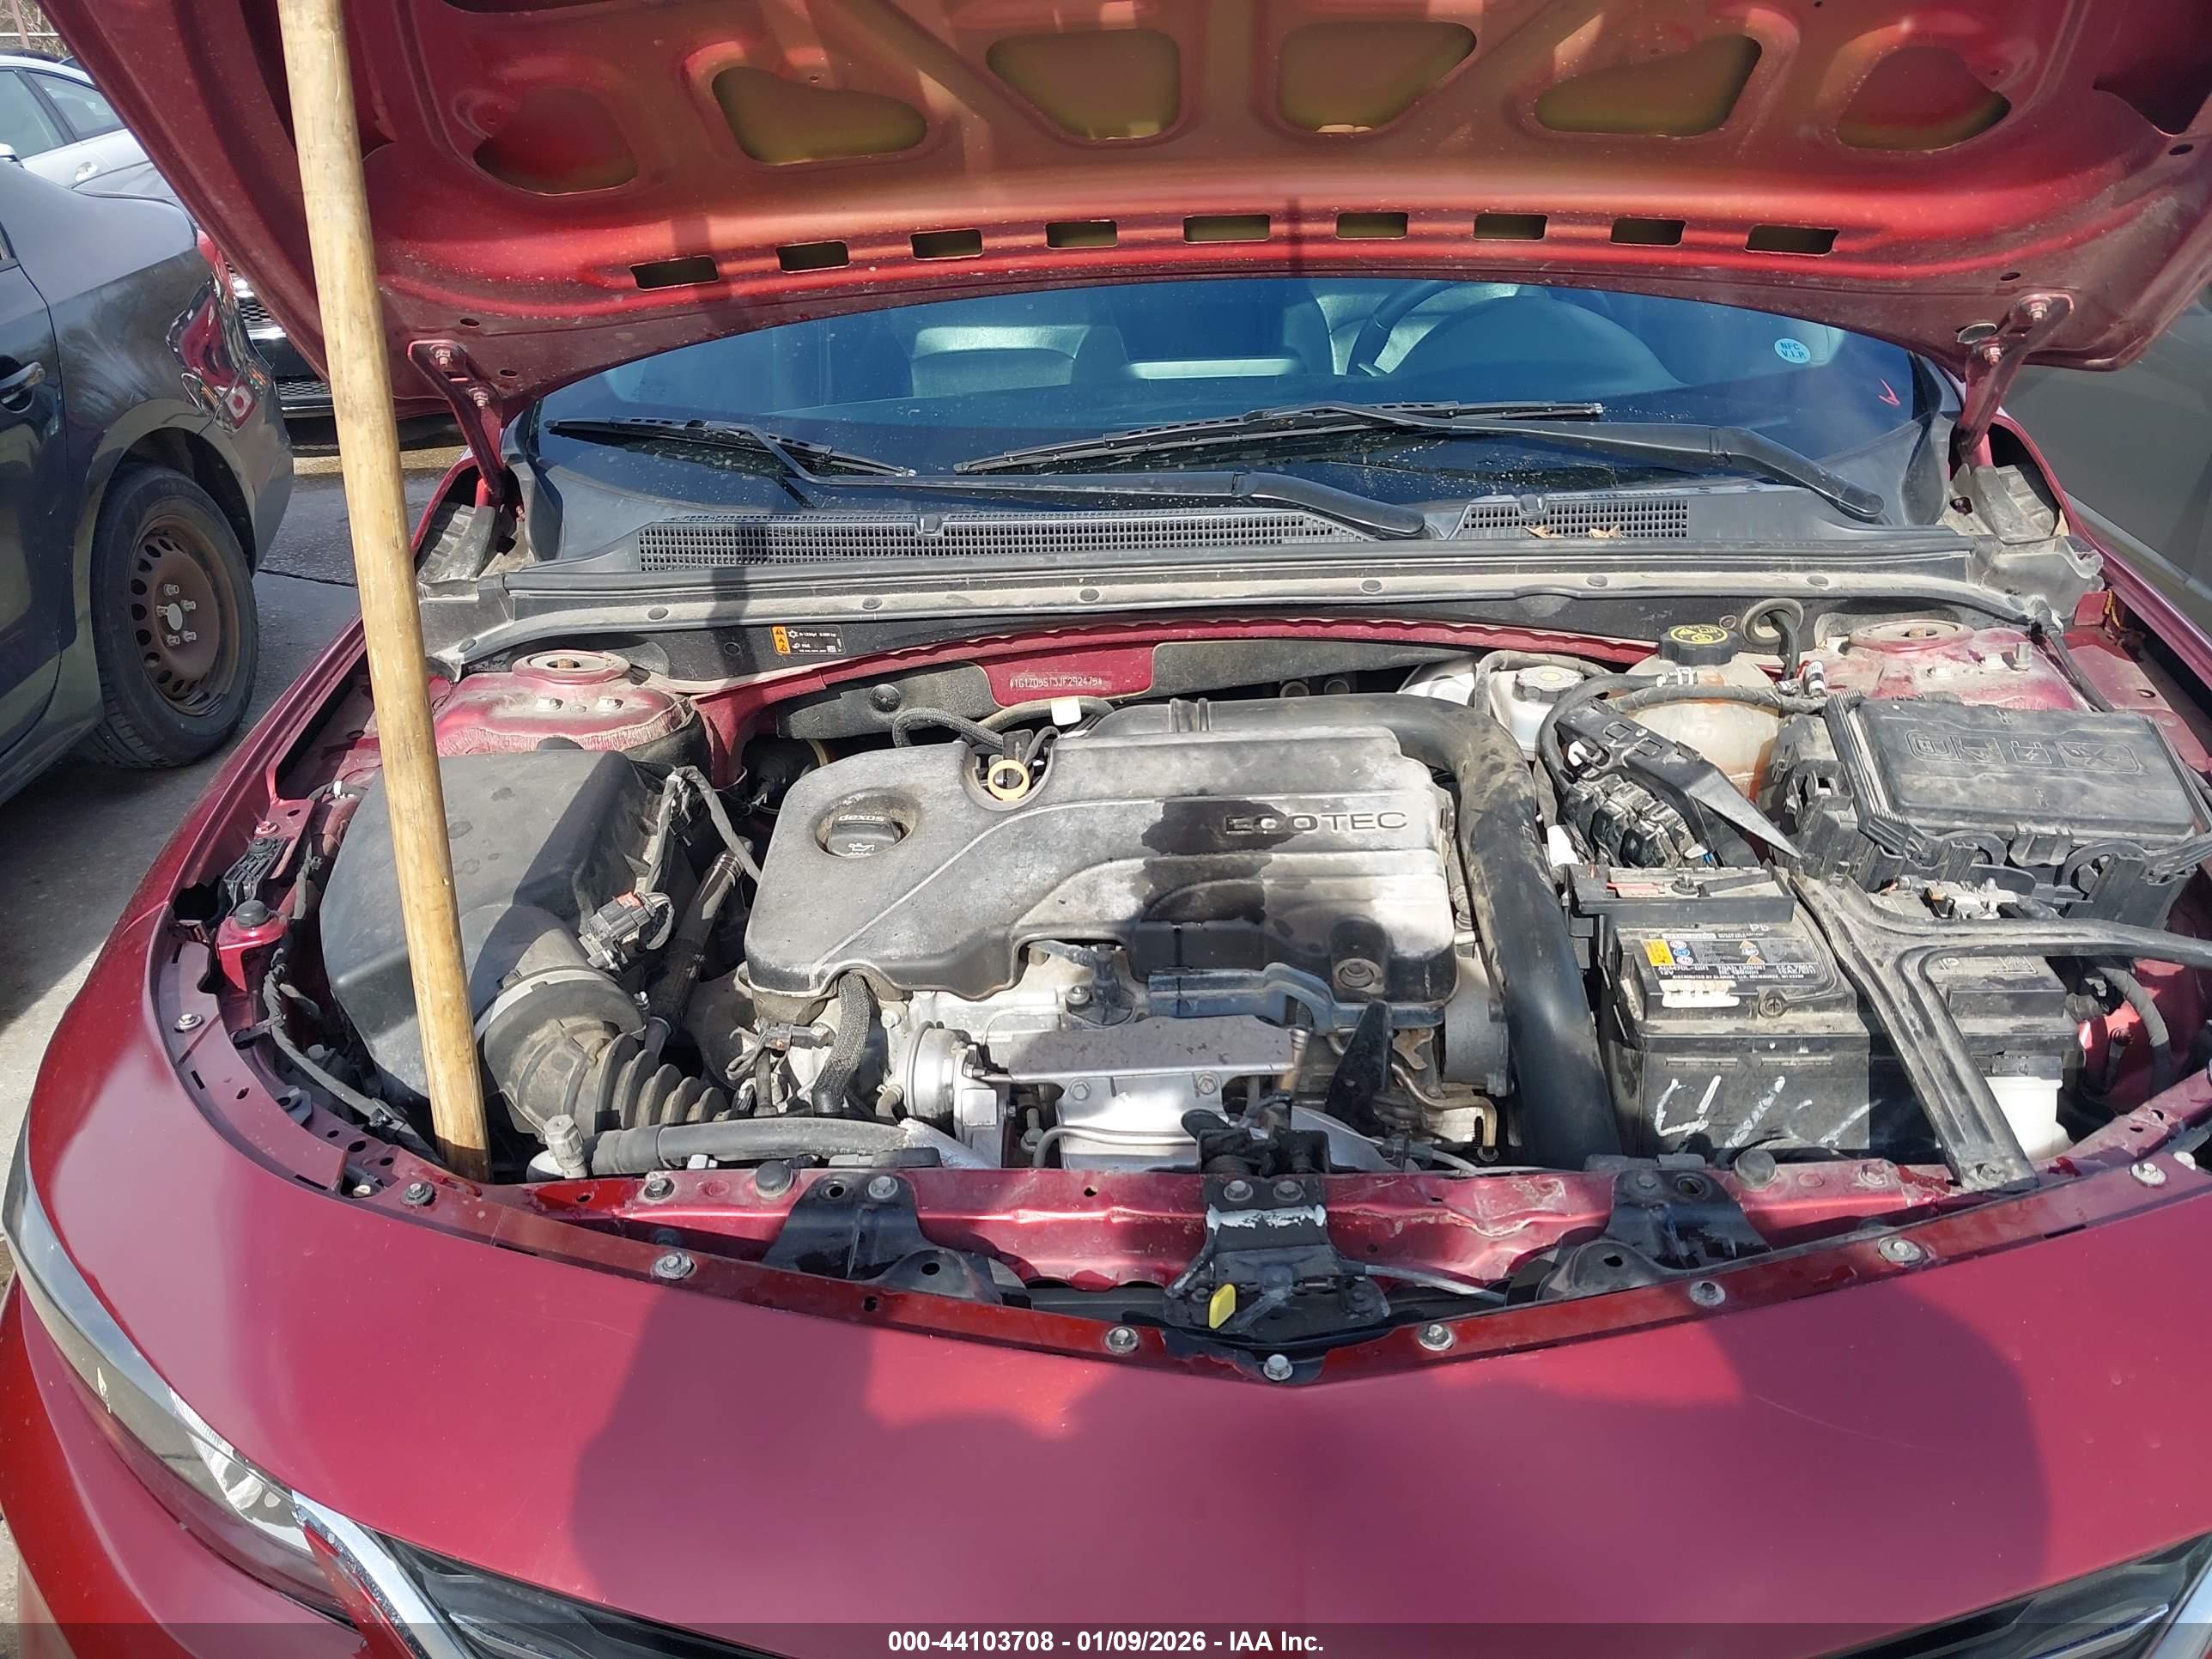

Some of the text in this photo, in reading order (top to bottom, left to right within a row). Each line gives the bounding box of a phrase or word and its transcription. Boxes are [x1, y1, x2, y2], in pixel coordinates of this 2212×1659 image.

[1780, 342, 1800, 350] NFC
[1224, 811, 1408, 834] ECOTEC
[1749, 922, 1769, 932] Pb
